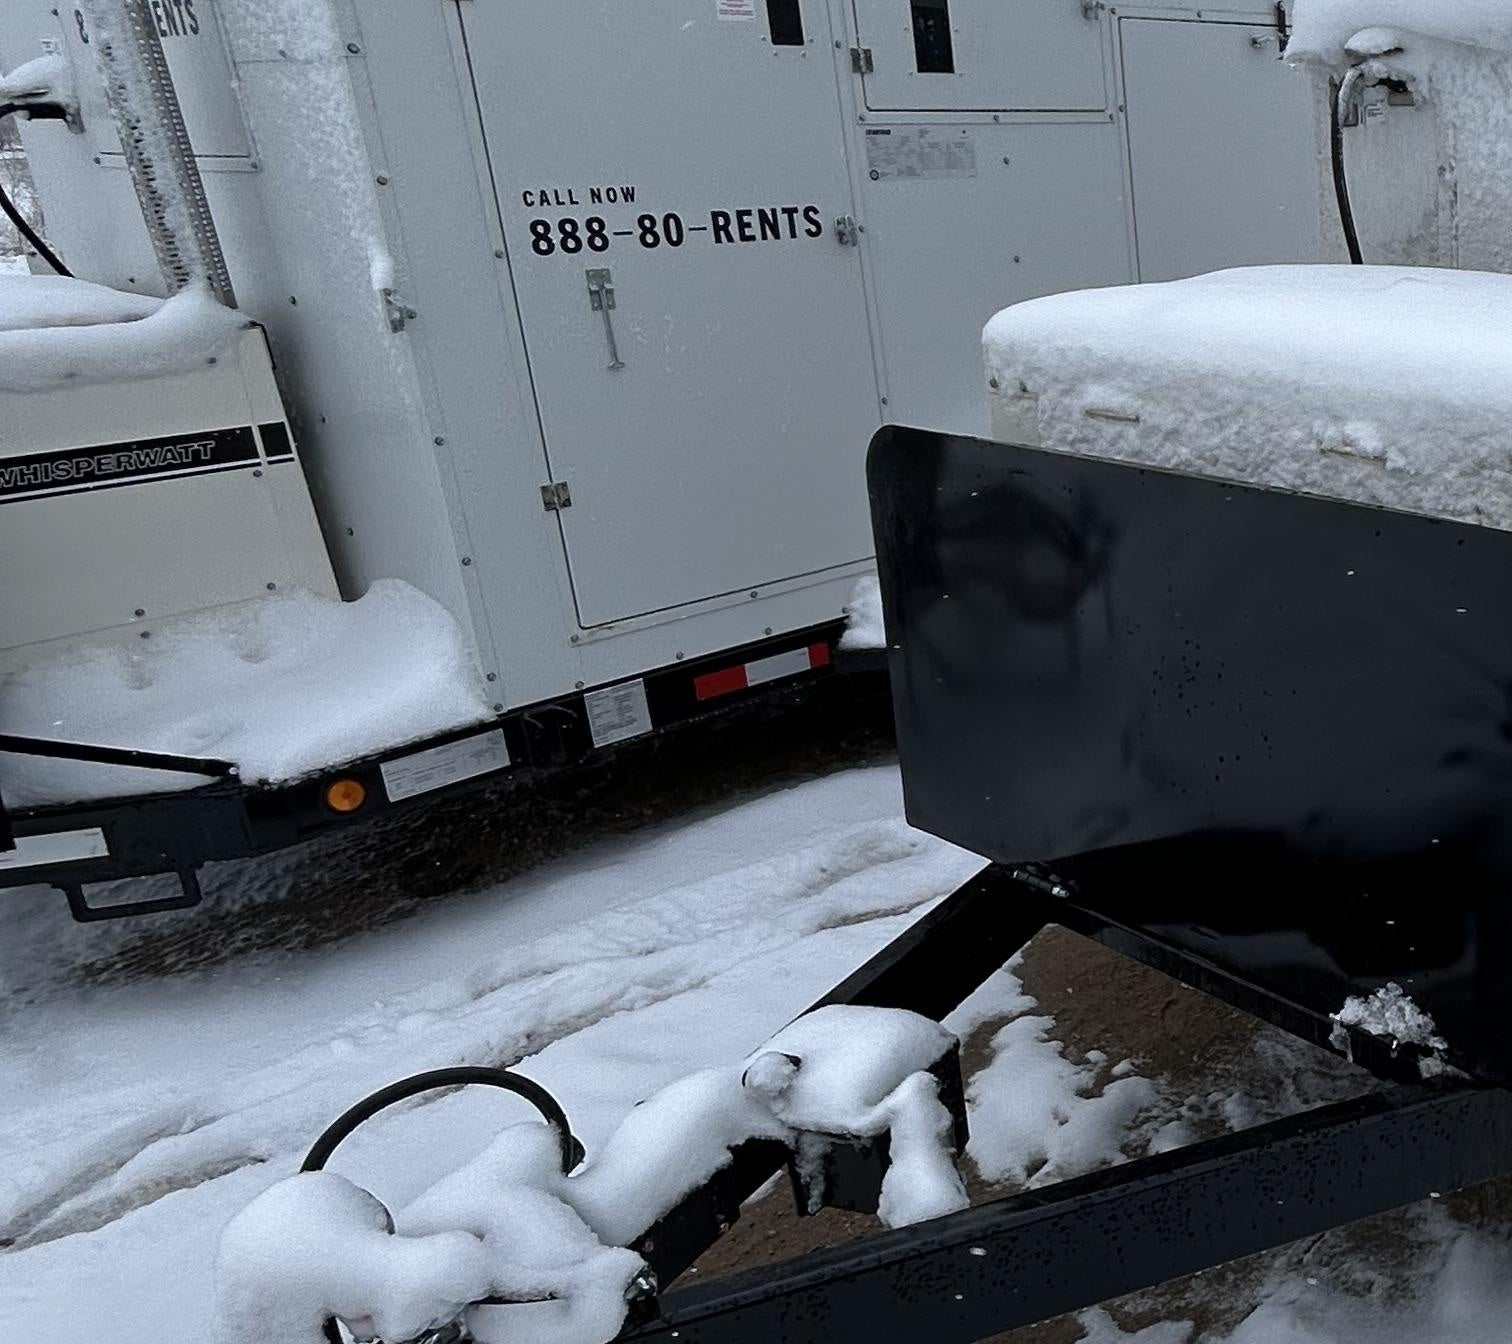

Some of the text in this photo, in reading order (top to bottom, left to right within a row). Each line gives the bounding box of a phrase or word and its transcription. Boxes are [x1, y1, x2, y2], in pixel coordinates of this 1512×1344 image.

[522, 186, 636, 207] CALL NOW
[529, 205, 823, 256] 888-80-RENTS
